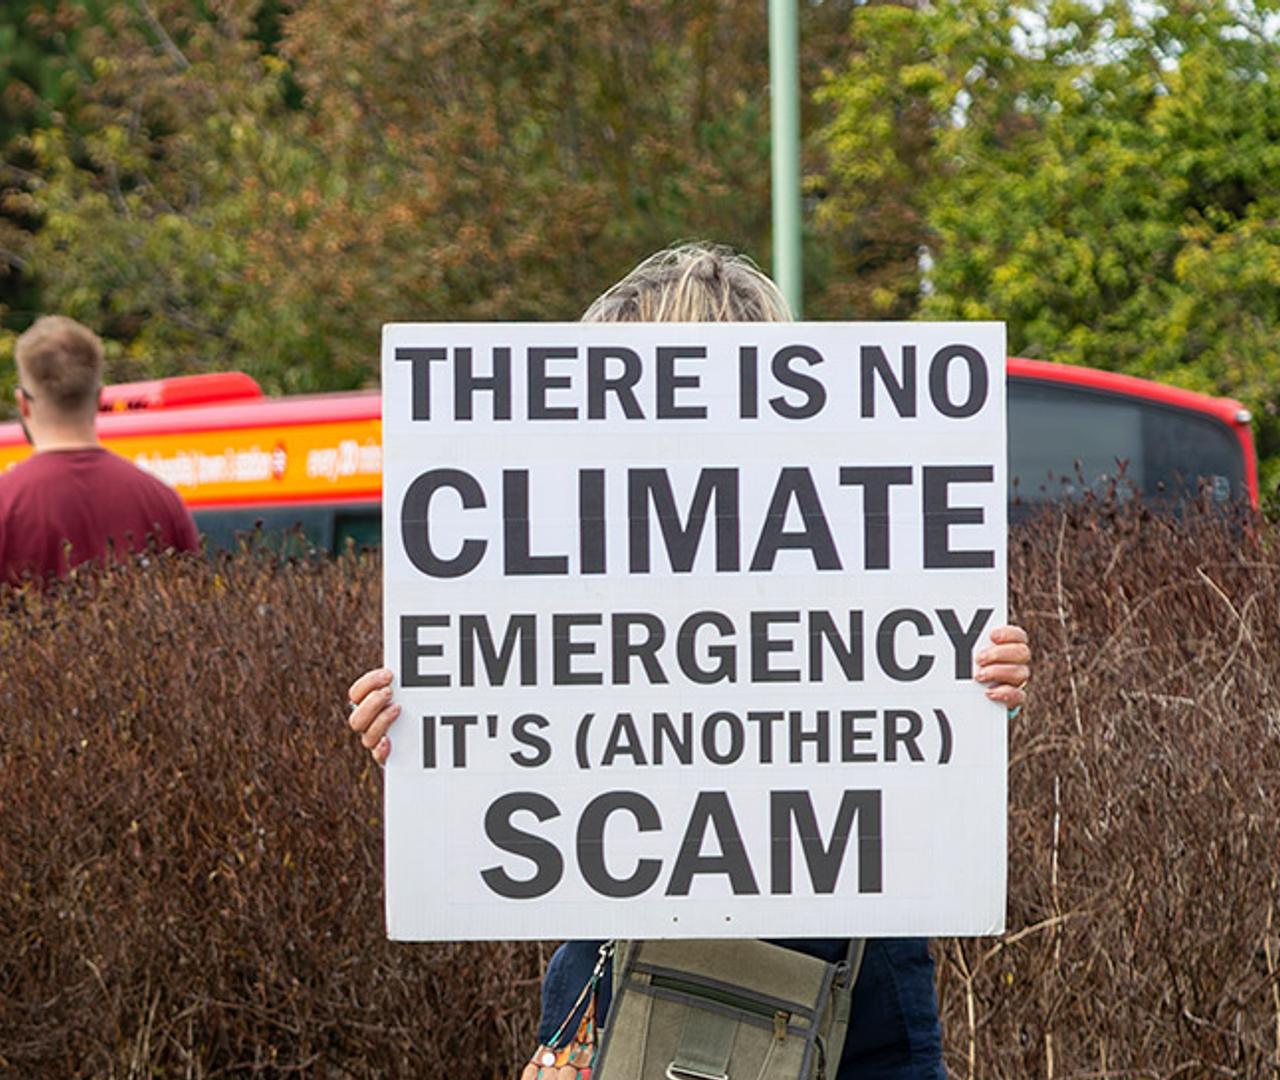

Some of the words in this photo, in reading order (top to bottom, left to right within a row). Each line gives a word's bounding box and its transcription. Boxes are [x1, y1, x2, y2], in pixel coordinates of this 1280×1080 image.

[394, 346, 709, 422] THERE
[739, 344, 827, 420] IS
[859, 344, 989, 419] NO
[400, 464, 996, 579] CLIMATE
[399, 608, 995, 689] EMERGENCY
[421, 713, 552, 769] IT'S
[575, 708, 954, 770] (ANOTHER)
[479, 789, 883, 900] SCAM
